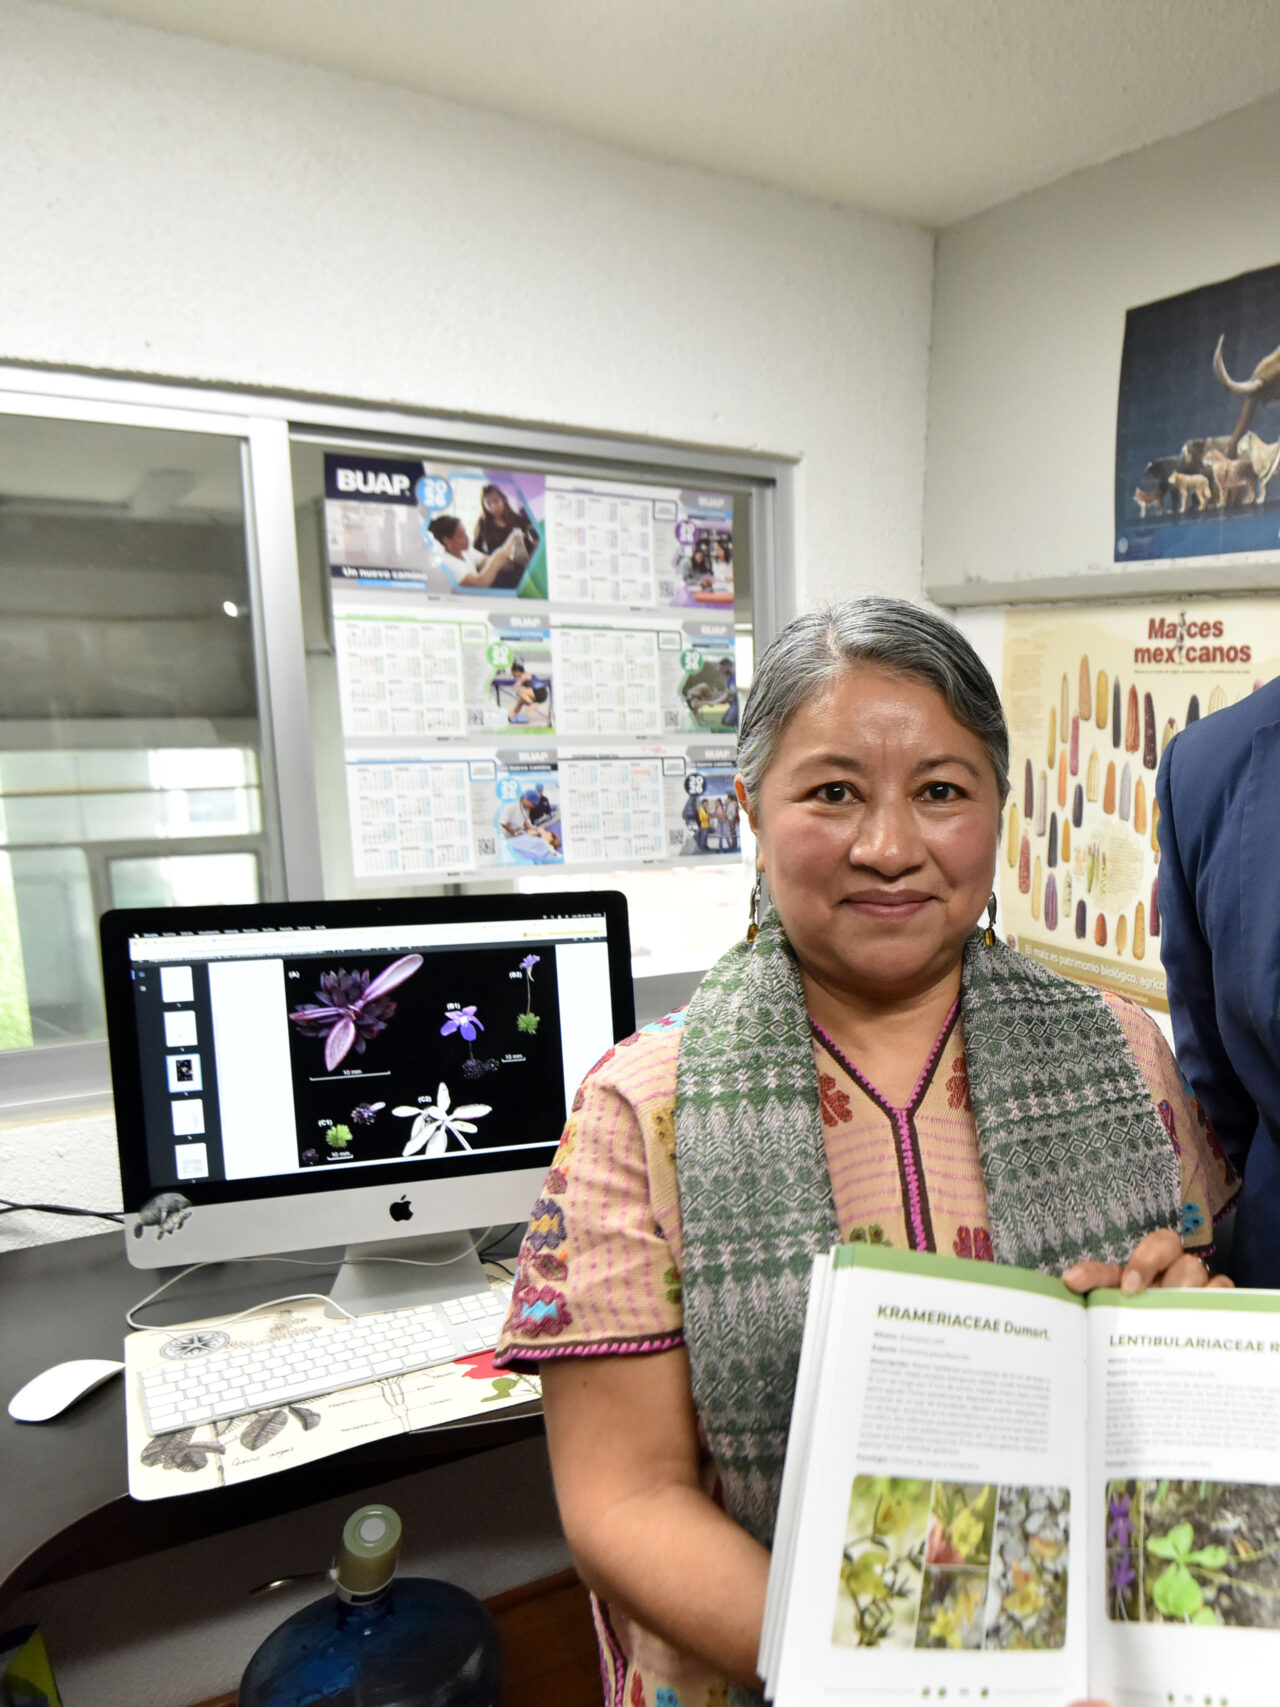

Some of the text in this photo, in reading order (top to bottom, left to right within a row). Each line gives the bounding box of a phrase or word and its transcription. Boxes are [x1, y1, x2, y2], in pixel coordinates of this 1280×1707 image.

[336, 468, 411, 496] BUAP
[342, 566, 358, 577] Un
[359, 568, 390, 578] nuevo
[1059, 956, 1100, 975] patrimonio
[1139, 976, 1166, 992] agríco
[877, 1304, 1001, 1333] KRAMERIACEAE
[1109, 1333, 1265, 1353] LENTIBULARIACEAE
